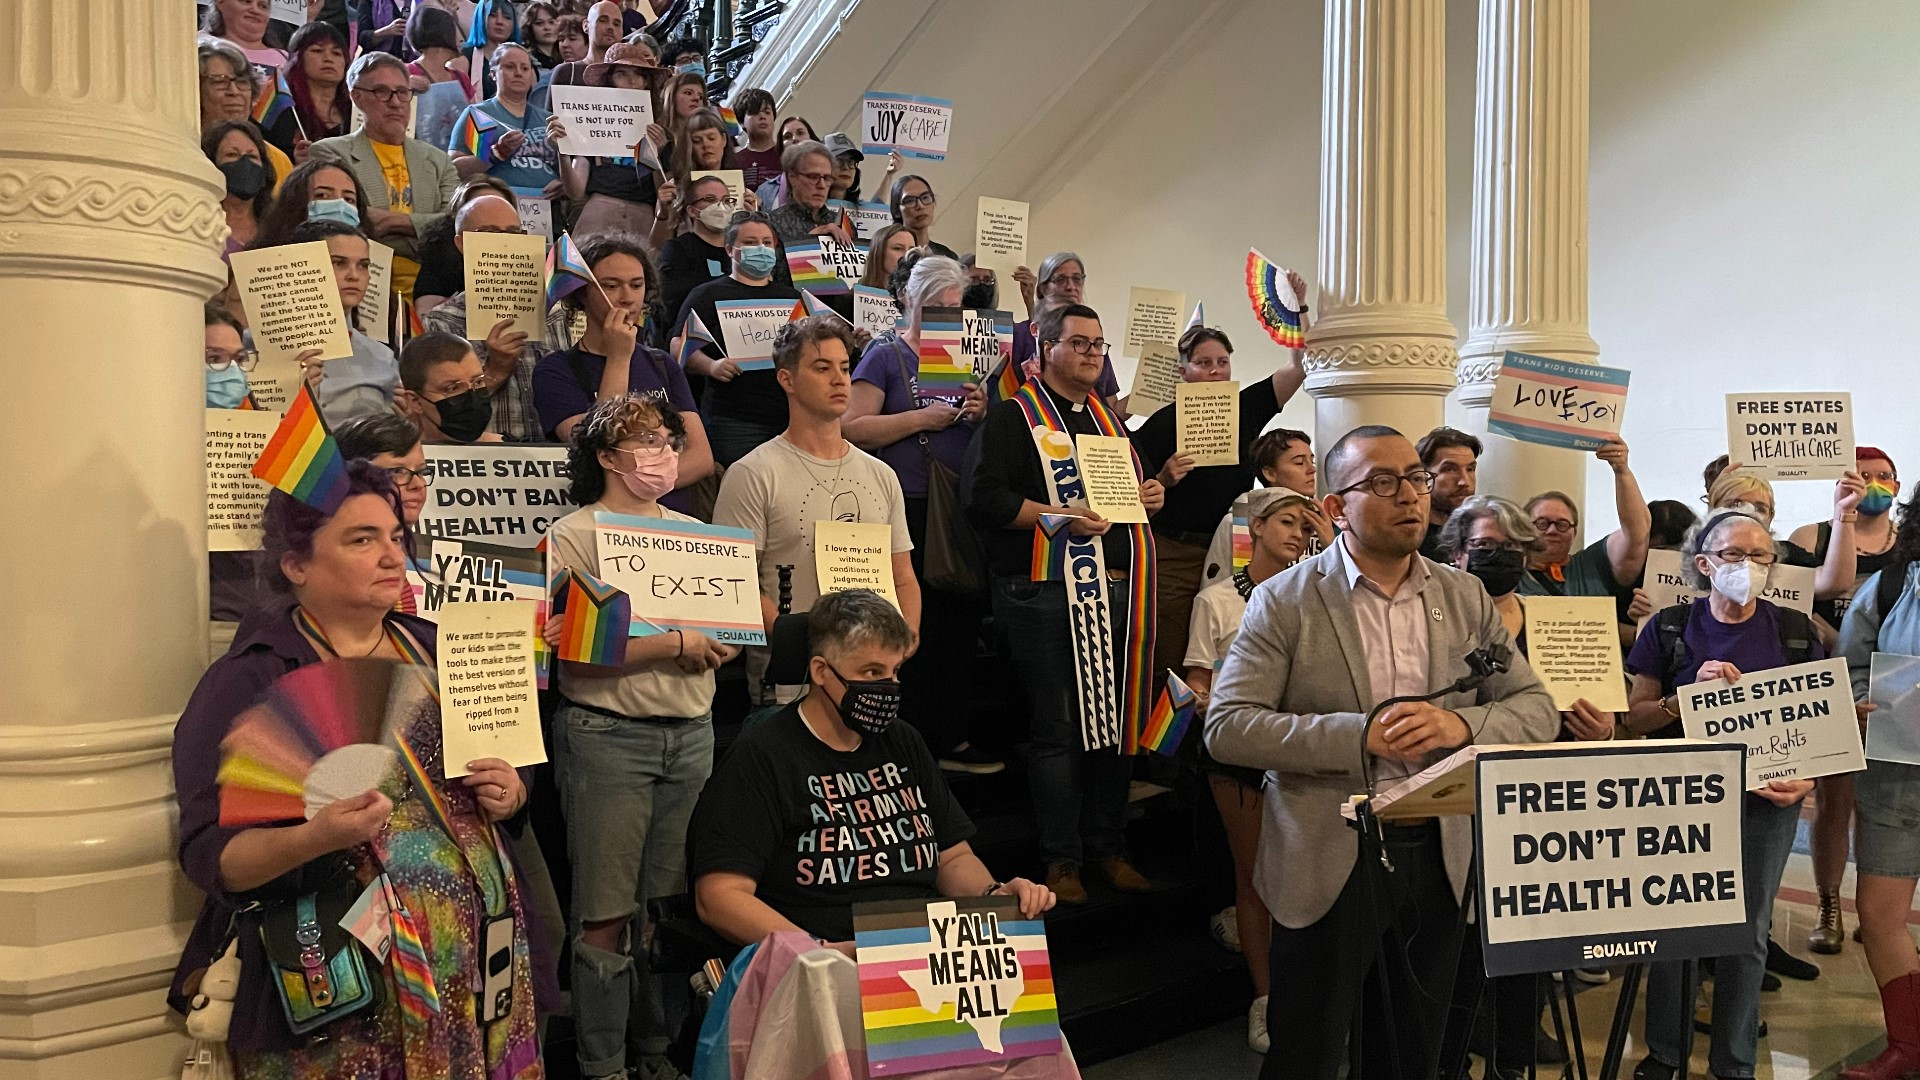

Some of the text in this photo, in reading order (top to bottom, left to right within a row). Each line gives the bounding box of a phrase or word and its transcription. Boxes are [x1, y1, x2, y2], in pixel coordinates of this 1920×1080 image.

[561, 103, 645, 112] TRANS HEALTHCARE
[871, 111, 904, 144] JOY
[901, 123, 907, 134] &
[822, 253, 866, 265] MEANS
[250, 274, 282, 284] allowed
[837, 266, 862, 278] ALL
[859, 296, 887, 307] TRANS
[723, 311, 752, 319] TRANS
[862, 310, 895, 326] HONO
[286, 332, 316, 341] people.
[965, 319, 995, 337] Y'ALL
[961, 337, 998, 355] MEANS
[1514, 356, 1541, 367] TRANS
[1545, 363, 1565, 372] KIDS
[1514, 384, 1578, 408] LOVE
[1578, 401, 1616, 423] JOY
[1737, 401, 1843, 414] FREE STATES
[1746, 422, 1837, 435] DON'T BAN
[425, 459, 568, 477] FREE STATE
[436, 488, 579, 507] DON'T BAN
[424, 517, 526, 536] HEALTH
[604, 533, 648, 548] TRANS
[653, 538, 682, 551] KIDS
[435, 553, 507, 589] Y'ALL
[604, 555, 645, 572] TO
[1657, 573, 1687, 586] TRA
[651, 575, 745, 605] EXIST
[716, 631, 763, 642] EQUALITY
[451, 646, 465, 654] our
[449, 679, 529, 694] themselves without
[1692, 671, 1834, 711] FREE STATES
[453, 693, 527, 707] fear of them being
[469, 722, 493, 731] loving
[1705, 700, 1830, 736] DON'T BAN
[1770, 729, 1807, 761] Rights
[807, 762, 908, 799] GENDER-
[1759, 768, 1797, 781] EQUALITY
[1497, 774, 1725, 815] FREE STATES
[798, 813, 935, 852] HEALTHCAR
[1513, 823, 1711, 864] DON'T BAN
[796, 852, 890, 885] SAVES
[1493, 870, 1736, 917] HEALTH CARE
[932, 914, 1006, 948] Y'ALL
[1583, 940, 1657, 959] EQUALITY
[929, 947, 1017, 985] MEANS
[957, 984, 1008, 1020] ALL
